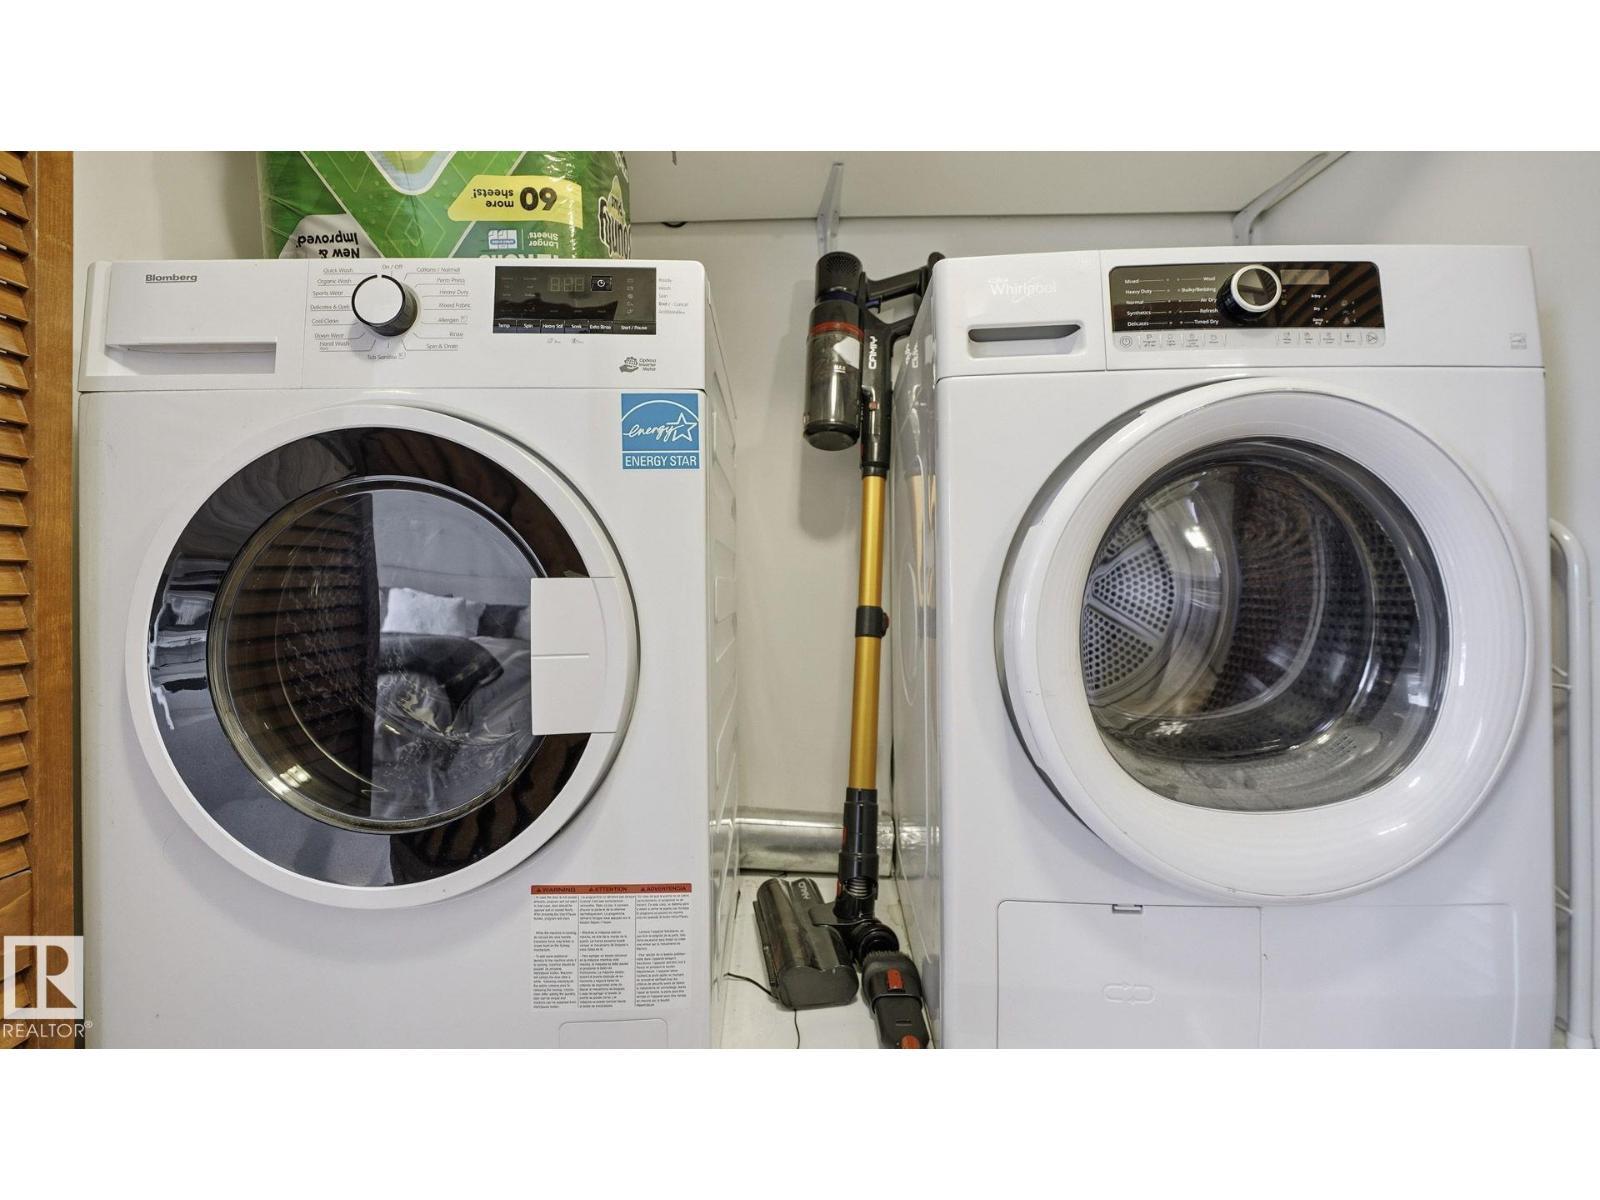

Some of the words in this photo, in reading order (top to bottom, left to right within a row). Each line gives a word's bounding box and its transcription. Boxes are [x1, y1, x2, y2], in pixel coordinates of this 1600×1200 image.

[473, 188, 514, 199] sheets!
[519, 186, 558, 211] 60
[485, 200, 515, 208] more
[528, 239, 559, 249] Longer
[332, 247, 360, 259] New
[145, 273, 198, 283] Blomberg
[623, 424, 685, 442] energy
[625, 455, 668, 467] ENERGY
[669, 455, 697, 467] STAR
[542, 886, 577, 894] WARNING
